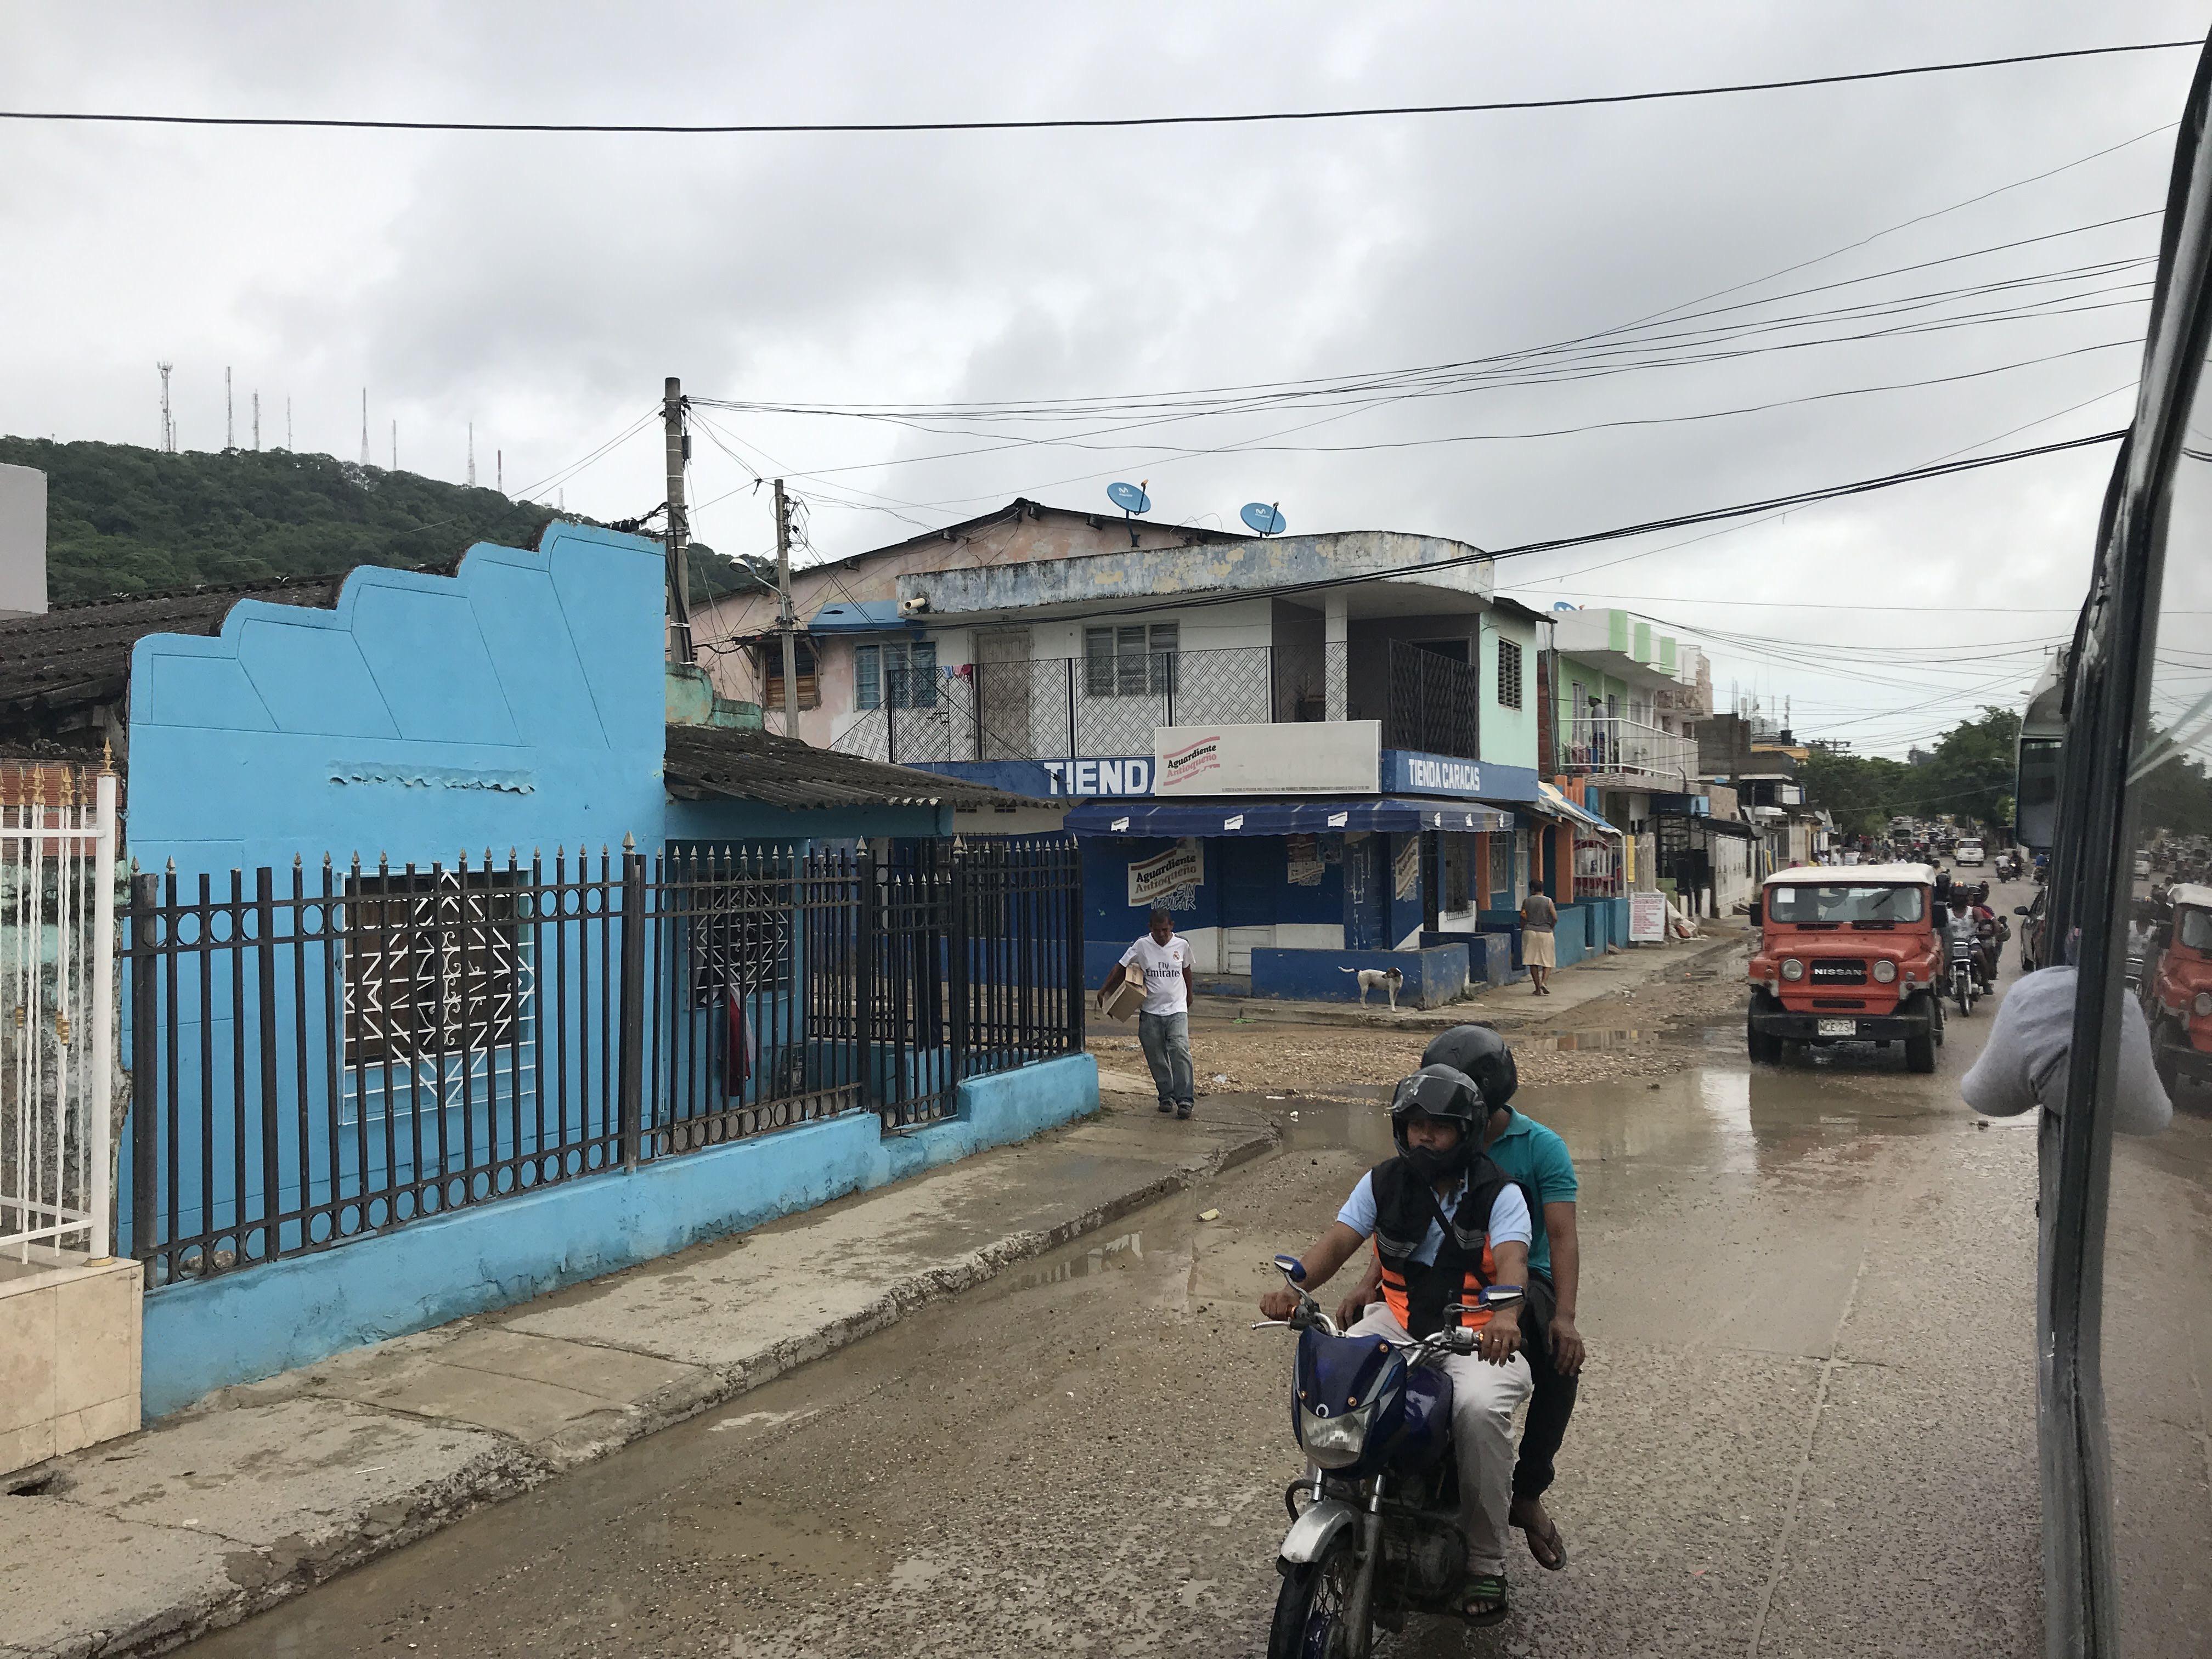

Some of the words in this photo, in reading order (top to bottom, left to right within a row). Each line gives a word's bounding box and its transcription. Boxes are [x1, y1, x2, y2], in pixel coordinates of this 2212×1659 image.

[1166, 753, 1217, 778] Antioqueño
[1167, 745, 1217, 769] Aguardiente
[1043, 760, 1155, 794] TIEND
[1408, 758, 1442, 788] TIENDA
[1442, 763, 1480, 791] CARACAS
[1135, 864, 1197, 894] Antioqueño
[1136, 855, 1195, 883] Aguardiente
[1176, 883, 1195, 896] SIN
[1146, 969, 1180, 978] Emirates
